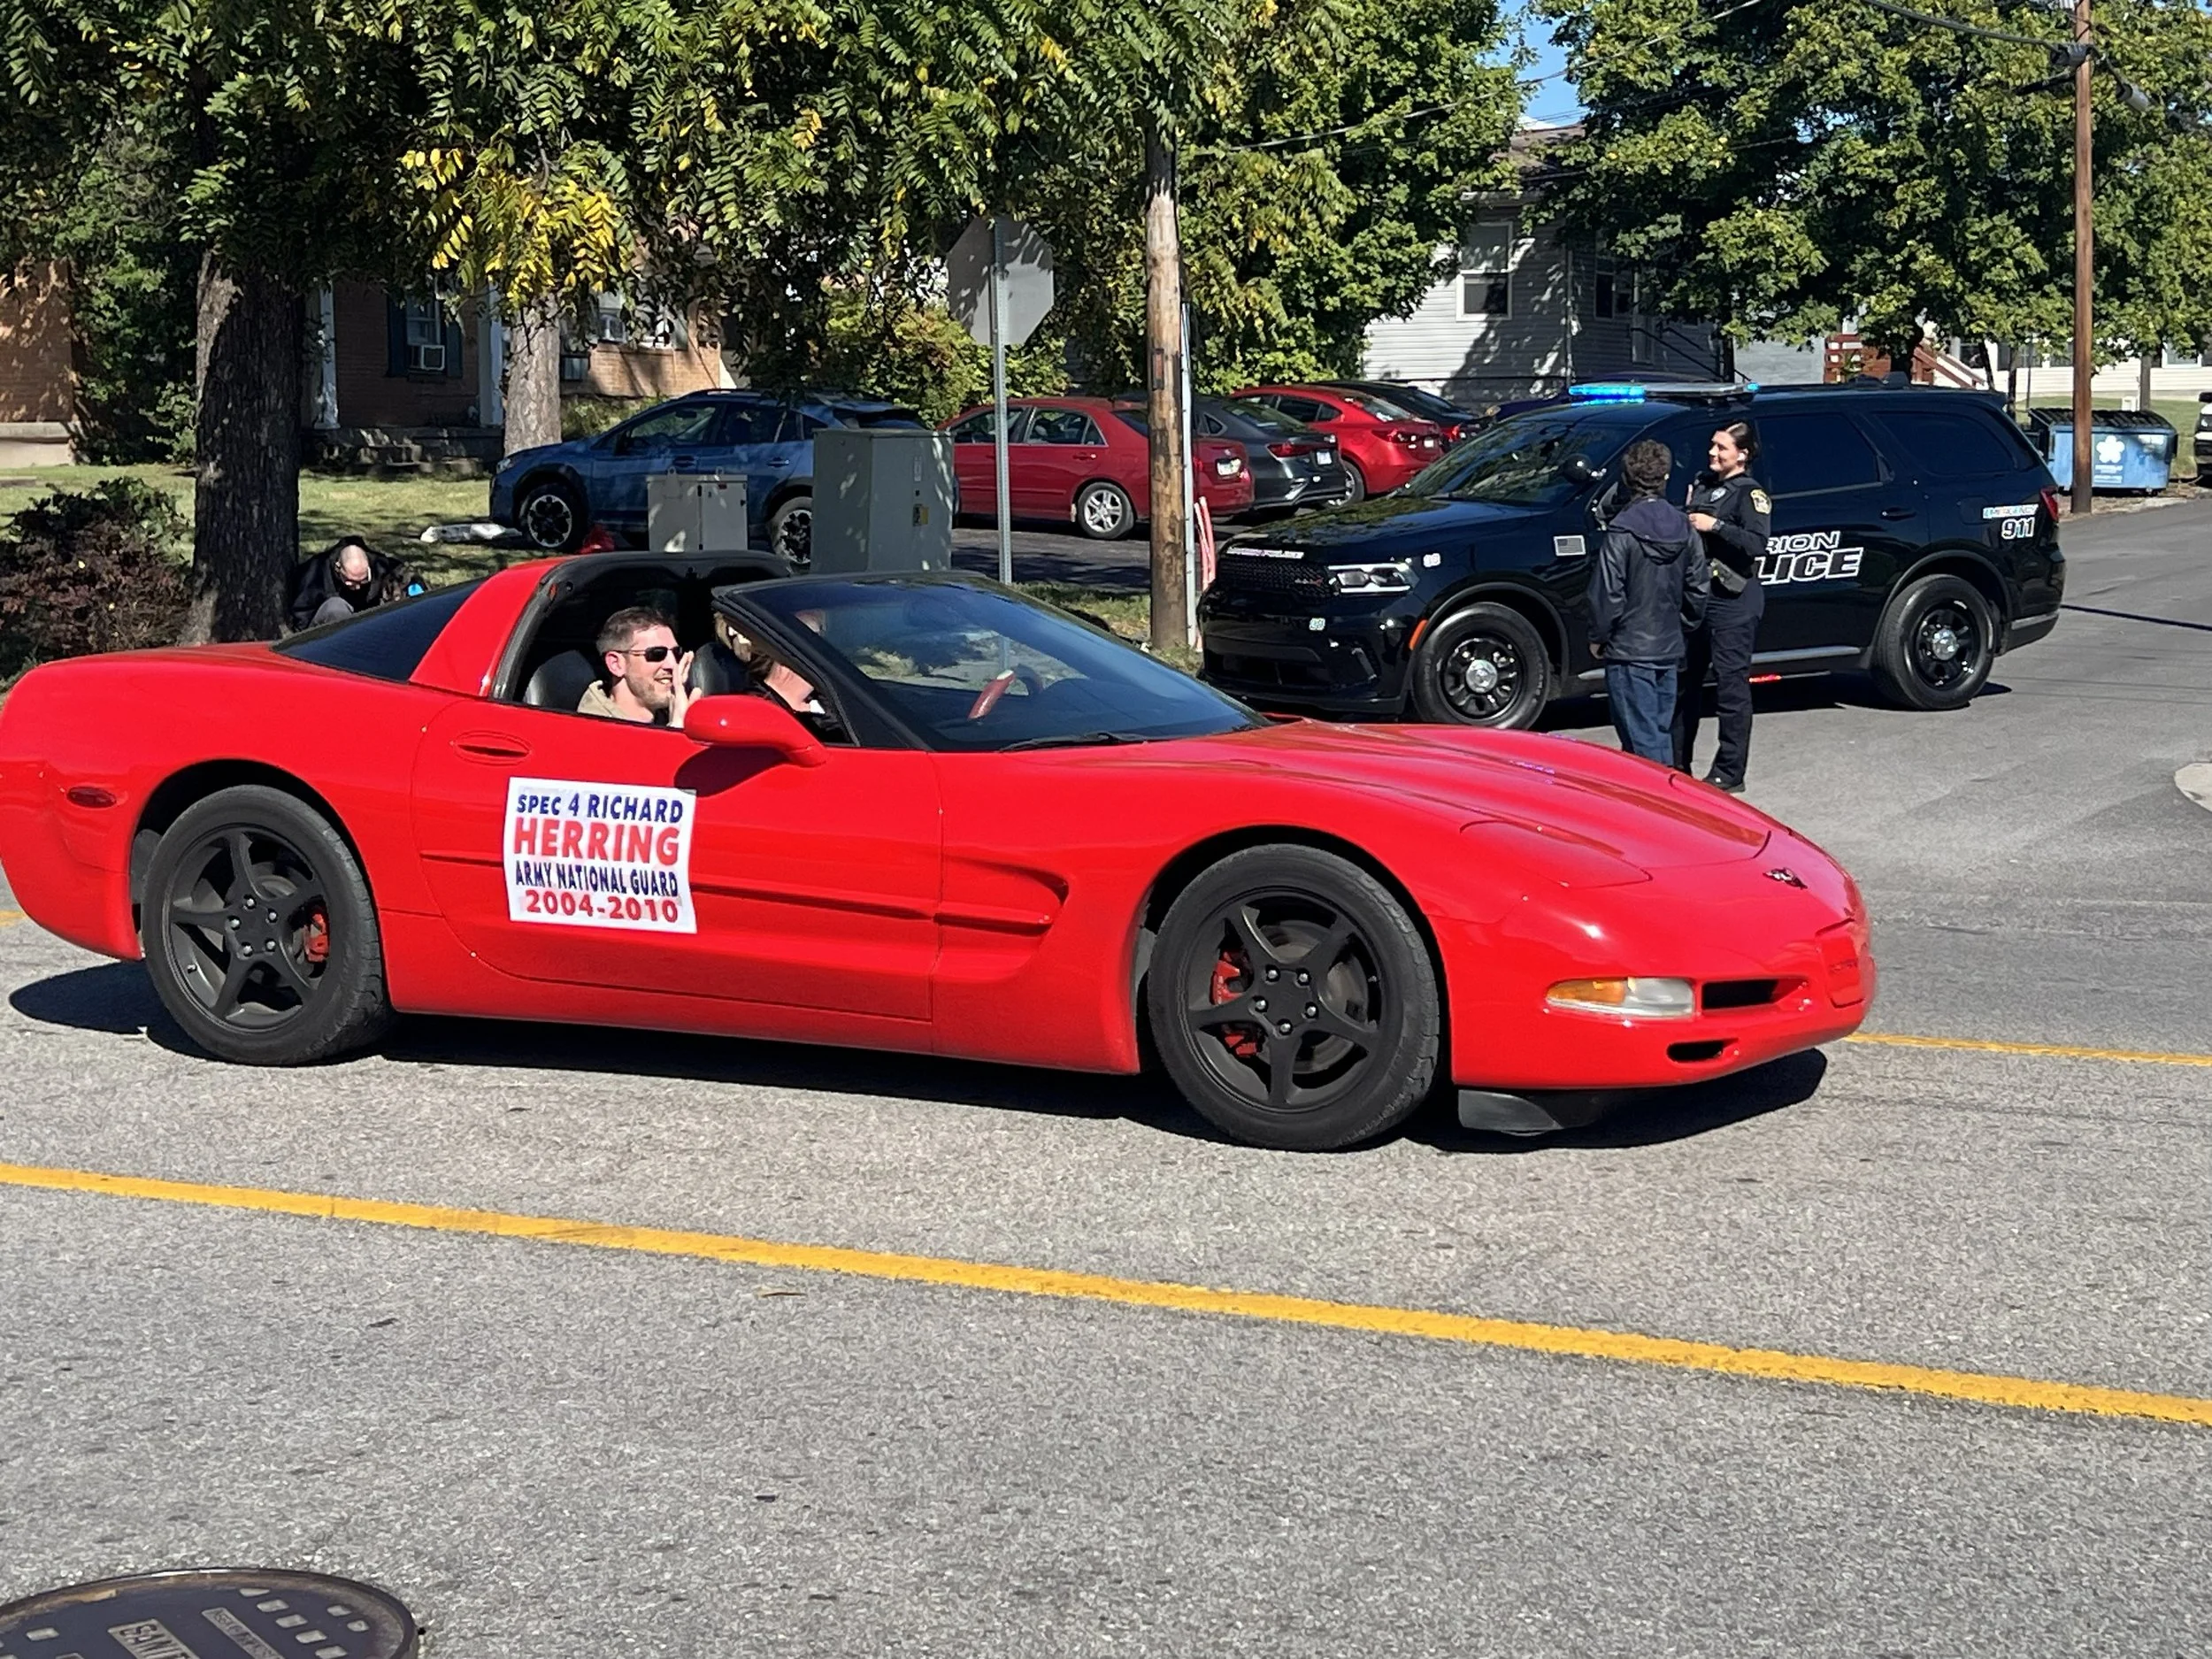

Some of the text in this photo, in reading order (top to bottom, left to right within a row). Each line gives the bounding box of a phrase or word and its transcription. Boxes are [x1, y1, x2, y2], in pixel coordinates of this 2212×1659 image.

[2001, 517, 2036, 540] 911
[516, 793, 683, 823] SPEC 4 RICHARD
[514, 817, 680, 866] HERRING
[515, 860, 678, 897] ARMY NATIONAL GUARD
[525, 889, 679, 923] 2004-2010
